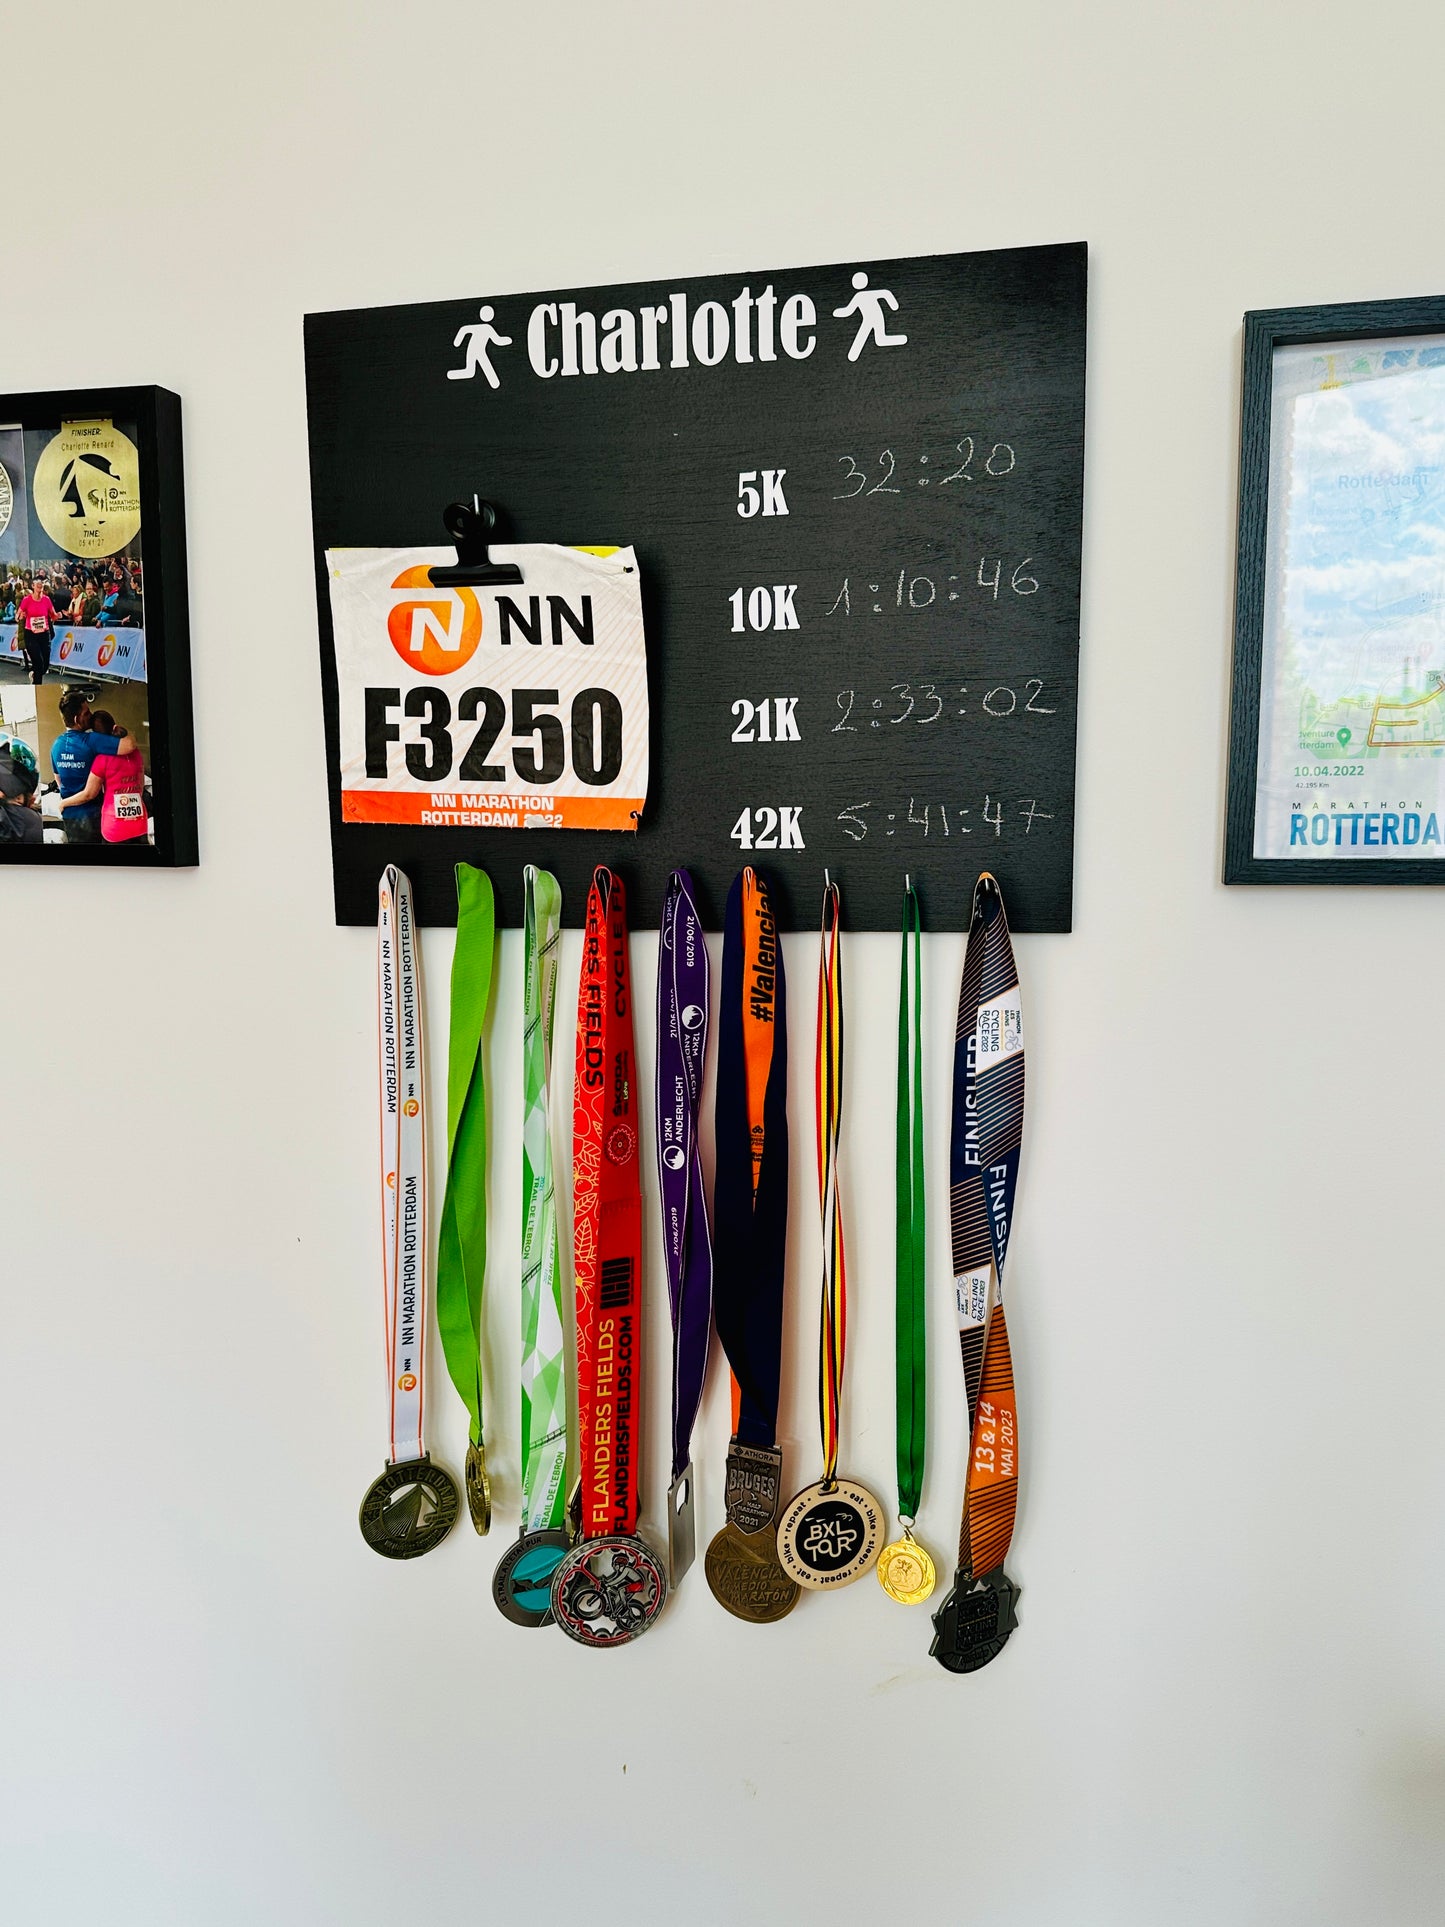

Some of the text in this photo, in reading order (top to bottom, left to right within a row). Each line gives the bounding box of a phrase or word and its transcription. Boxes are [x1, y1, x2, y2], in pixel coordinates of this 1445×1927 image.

[527, 284, 817, 379] Charlotte
[61, 440, 114, 452] Charlotte Renard
[833, 436, 1016, 499] 32:20
[736, 469, 789, 518] 5K
[1338, 471, 1428, 489] Rottedam
[728, 585, 800, 632] 10K
[825, 557, 1040, 615] 1:10:46
[494, 595, 595, 646] NN
[73, 642, 84, 653] NN
[116, 645, 131, 658] NN
[731, 697, 801, 742] 21K
[831, 679, 1056, 732] 2:33:02
[61, 753, 75, 761] TEAM
[364, 686, 623, 786] F3250
[1294, 765, 1365, 777] 10.04.2022
[117, 805, 142, 817] F3250
[421, 810, 563, 829] ROTTERDAM 222
[431, 794, 554, 811] NN MARATHON
[837, 795, 1055, 841] 5:41:47
[730, 806, 805, 849] 42K
[1290, 812, 1445, 846] ROTTERDA
[686, 915, 695, 968] 21/06/2019
[400, 895, 415, 1069] NN MARATHON ROTTERDAM
[585, 882, 602, 1087] DERS FIELDS
[613, 923, 626, 1018] CYCLE
[383, 940, 396, 1113] NN MARATHON ROTTERDAM
[692, 1032, 701, 1056] 12KM
[979, 1010, 990, 1035] RACE
[990, 1010, 999, 1052] CYCLING
[665, 1117, 673, 1142] 12KM
[675, 1076, 684, 1143] ANDERLECHT
[523, 1177, 540, 1260] TRAIL DE L'EBRON
[671, 1207, 679, 1257] 21/06/2019
[990, 1164, 1007, 1268] FINISH
[402, 1176, 417, 1345] NN MARATHON ROTTERDAM
[971, 1278, 979, 1319] CYCLING
[977, 1297, 986, 1322] RACE
[597, 1319, 614, 1397] FIELDS
[614, 1315, 633, 1532] FLANDERSFIELDS.COM
[975, 1400, 996, 1473] 13 & 14
[1000, 1409, 1014, 1476] MAI 2023
[593, 1403, 612, 1523] FLANDERS
[744, 1450, 774, 1462] ATHORA
[376, 1466, 457, 1512] ROTTERDAM
[540, 1451, 565, 1529] TRAIL DE L'EBRON
[729, 1468, 775, 1500] BRUGES
[533, 1514, 541, 1529] 2021
[739, 1515, 759, 1526] 2021
[784, 1493, 877, 1584] eat bike sleep repeat eat bike repeat
[810, 1520, 850, 1541] BXL
[498, 1575, 507, 1596] TRAIL
[526, 1536, 542, 1547] PUR
[804, 1537, 852, 1562] TOUR
[731, 1589, 789, 1604] MARATÓN
[734, 1581, 768, 1591] MEDIO
